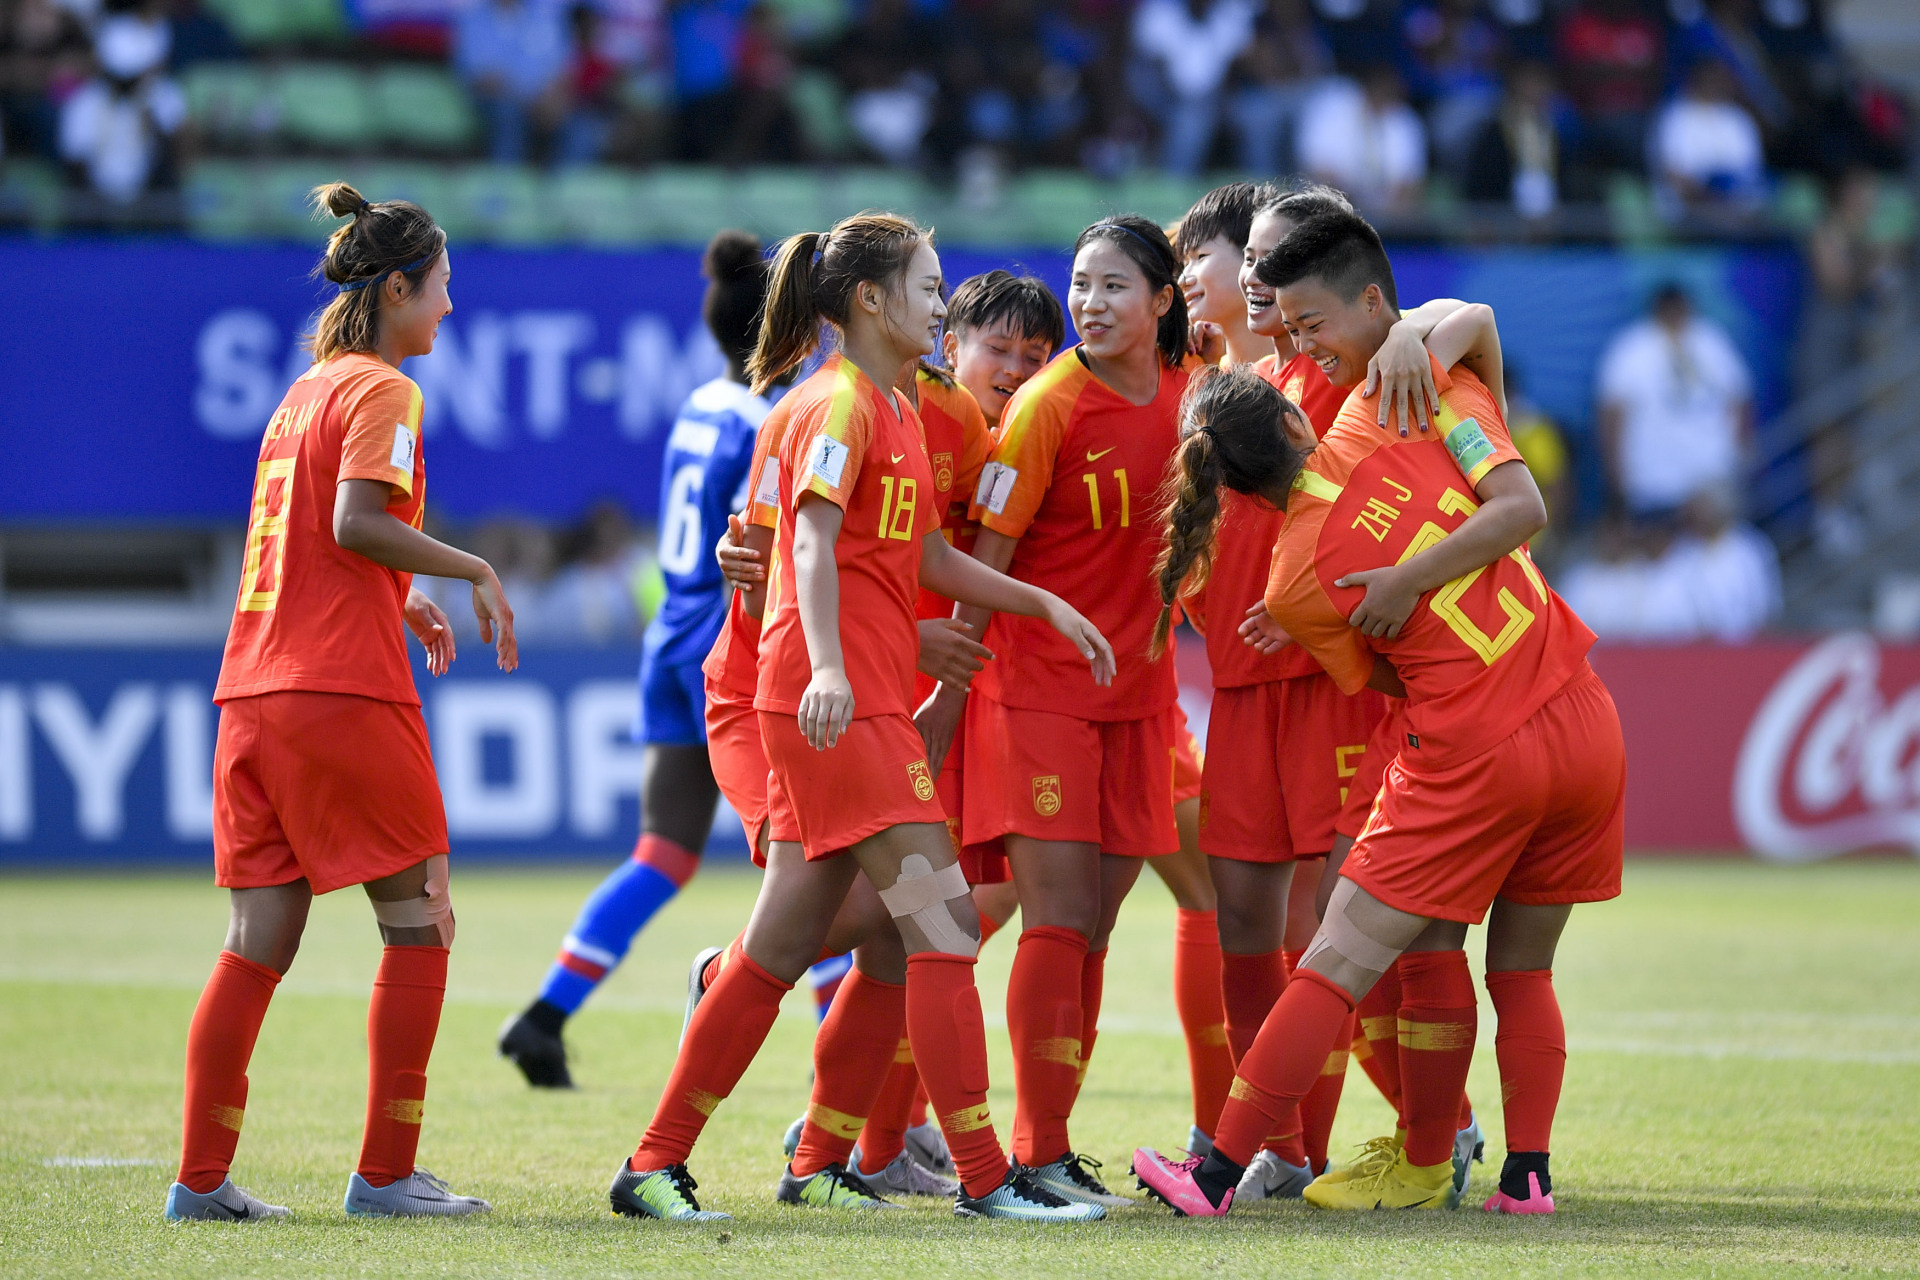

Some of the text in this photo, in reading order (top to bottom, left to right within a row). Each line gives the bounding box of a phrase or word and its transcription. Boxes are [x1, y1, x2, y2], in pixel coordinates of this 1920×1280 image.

[659, 462, 704, 576] 6
[878, 476, 917, 541] 18
[1083, 467, 1130, 530] 11
[1351, 477, 1413, 543] ZHI J
[239, 457, 296, 612] 8
[908, 761, 926, 774] CFA
[1034, 778, 1057, 788] CFA
